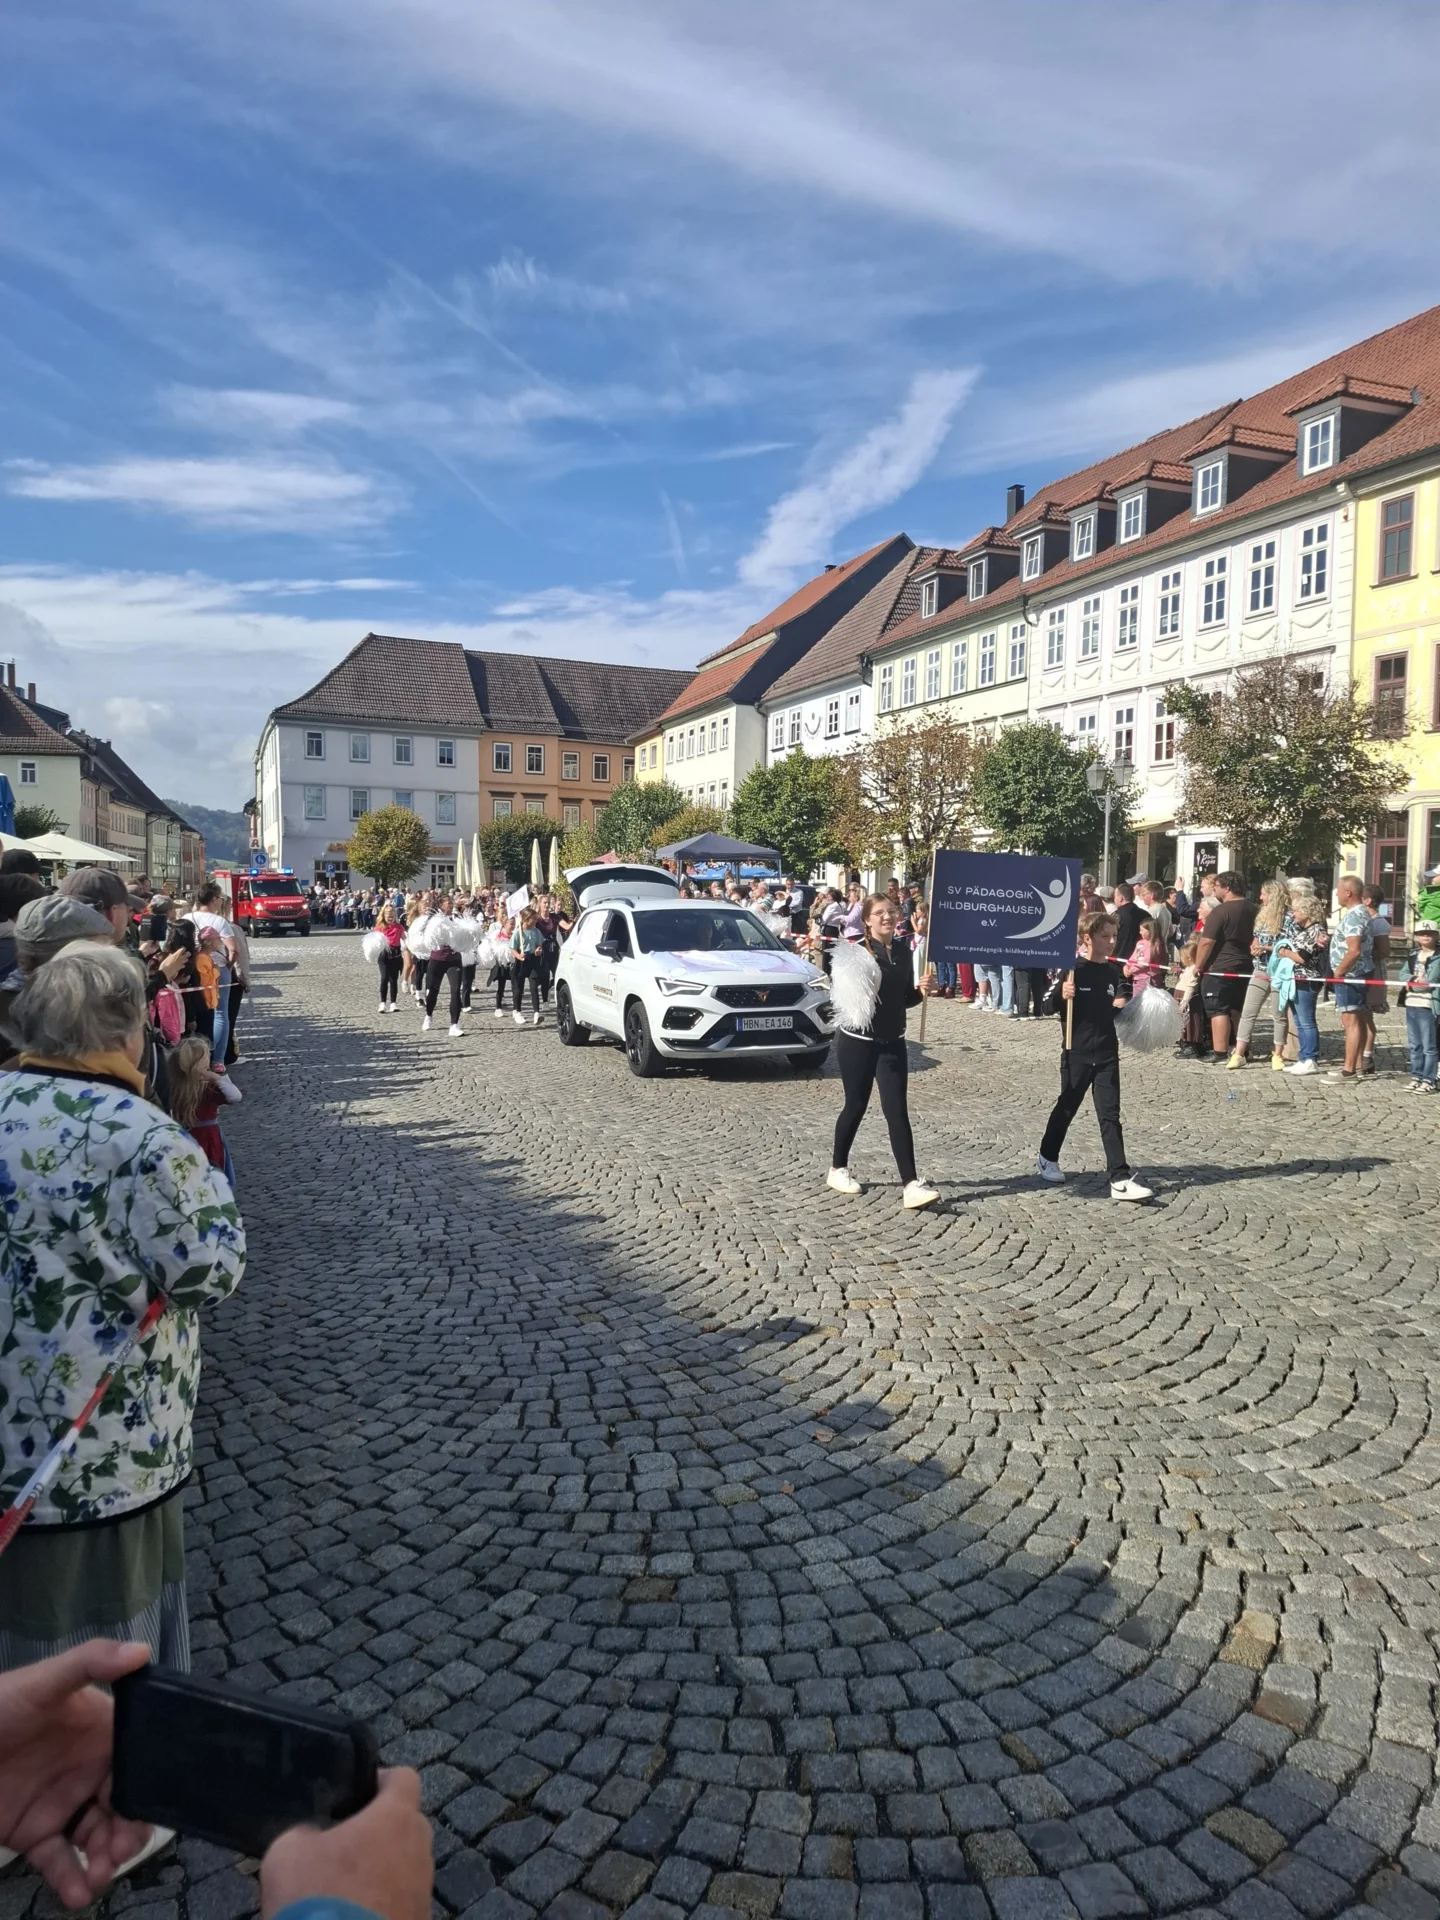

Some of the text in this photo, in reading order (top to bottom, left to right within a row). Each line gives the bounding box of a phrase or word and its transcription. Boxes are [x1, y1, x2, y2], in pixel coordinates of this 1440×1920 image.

[947, 885, 1034, 900] SV PÄDAGOGIK
[938, 900, 1042, 915] HILDBURGHAUSEN
[980, 919, 998, 927] e.V.
[944, 945, 1060, 957] www.sv-paedagogik-hildburghausen.de
[743, 1018, 792, 1029] HBN EA 146
